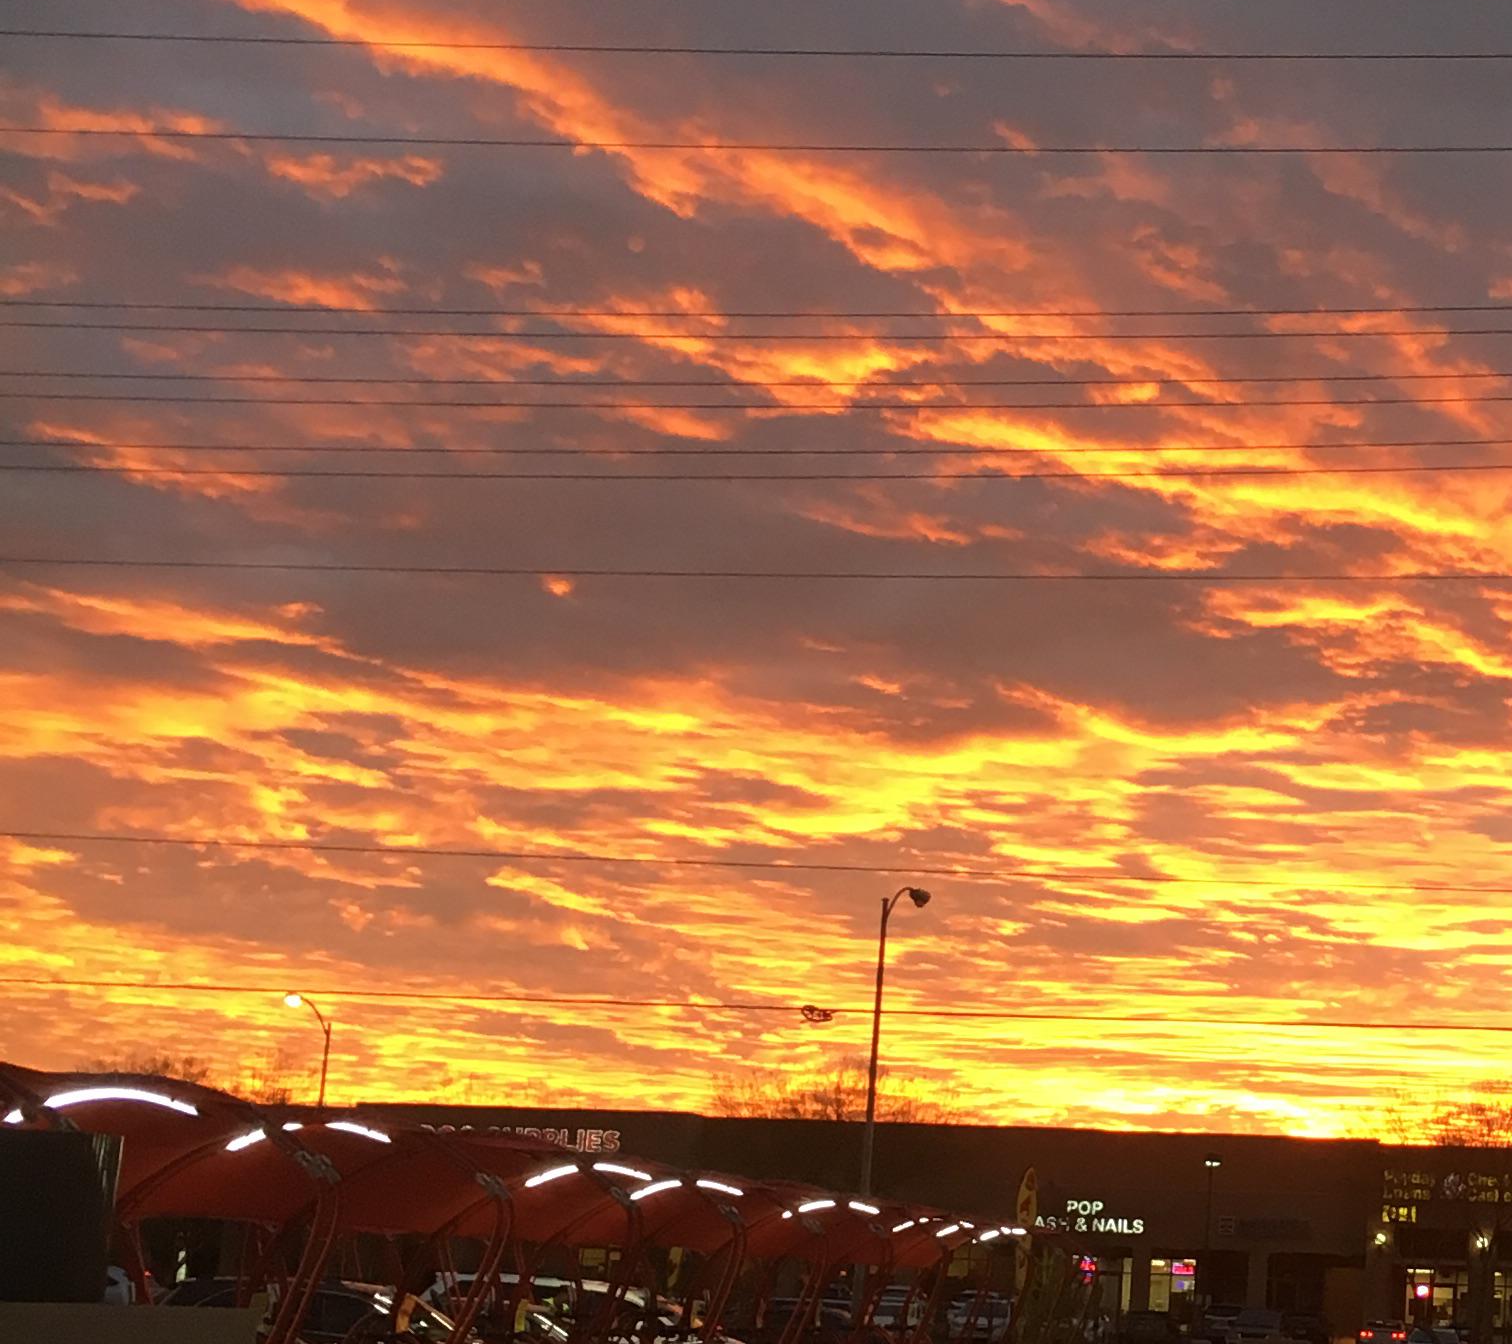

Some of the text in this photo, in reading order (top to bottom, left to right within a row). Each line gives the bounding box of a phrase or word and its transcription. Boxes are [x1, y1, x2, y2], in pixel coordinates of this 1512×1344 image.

[487, 1125, 621, 1153] PPLIES
[1066, 1199, 1104, 1216] POP
[1034, 1215, 1145, 1235] ASH & NAILS
